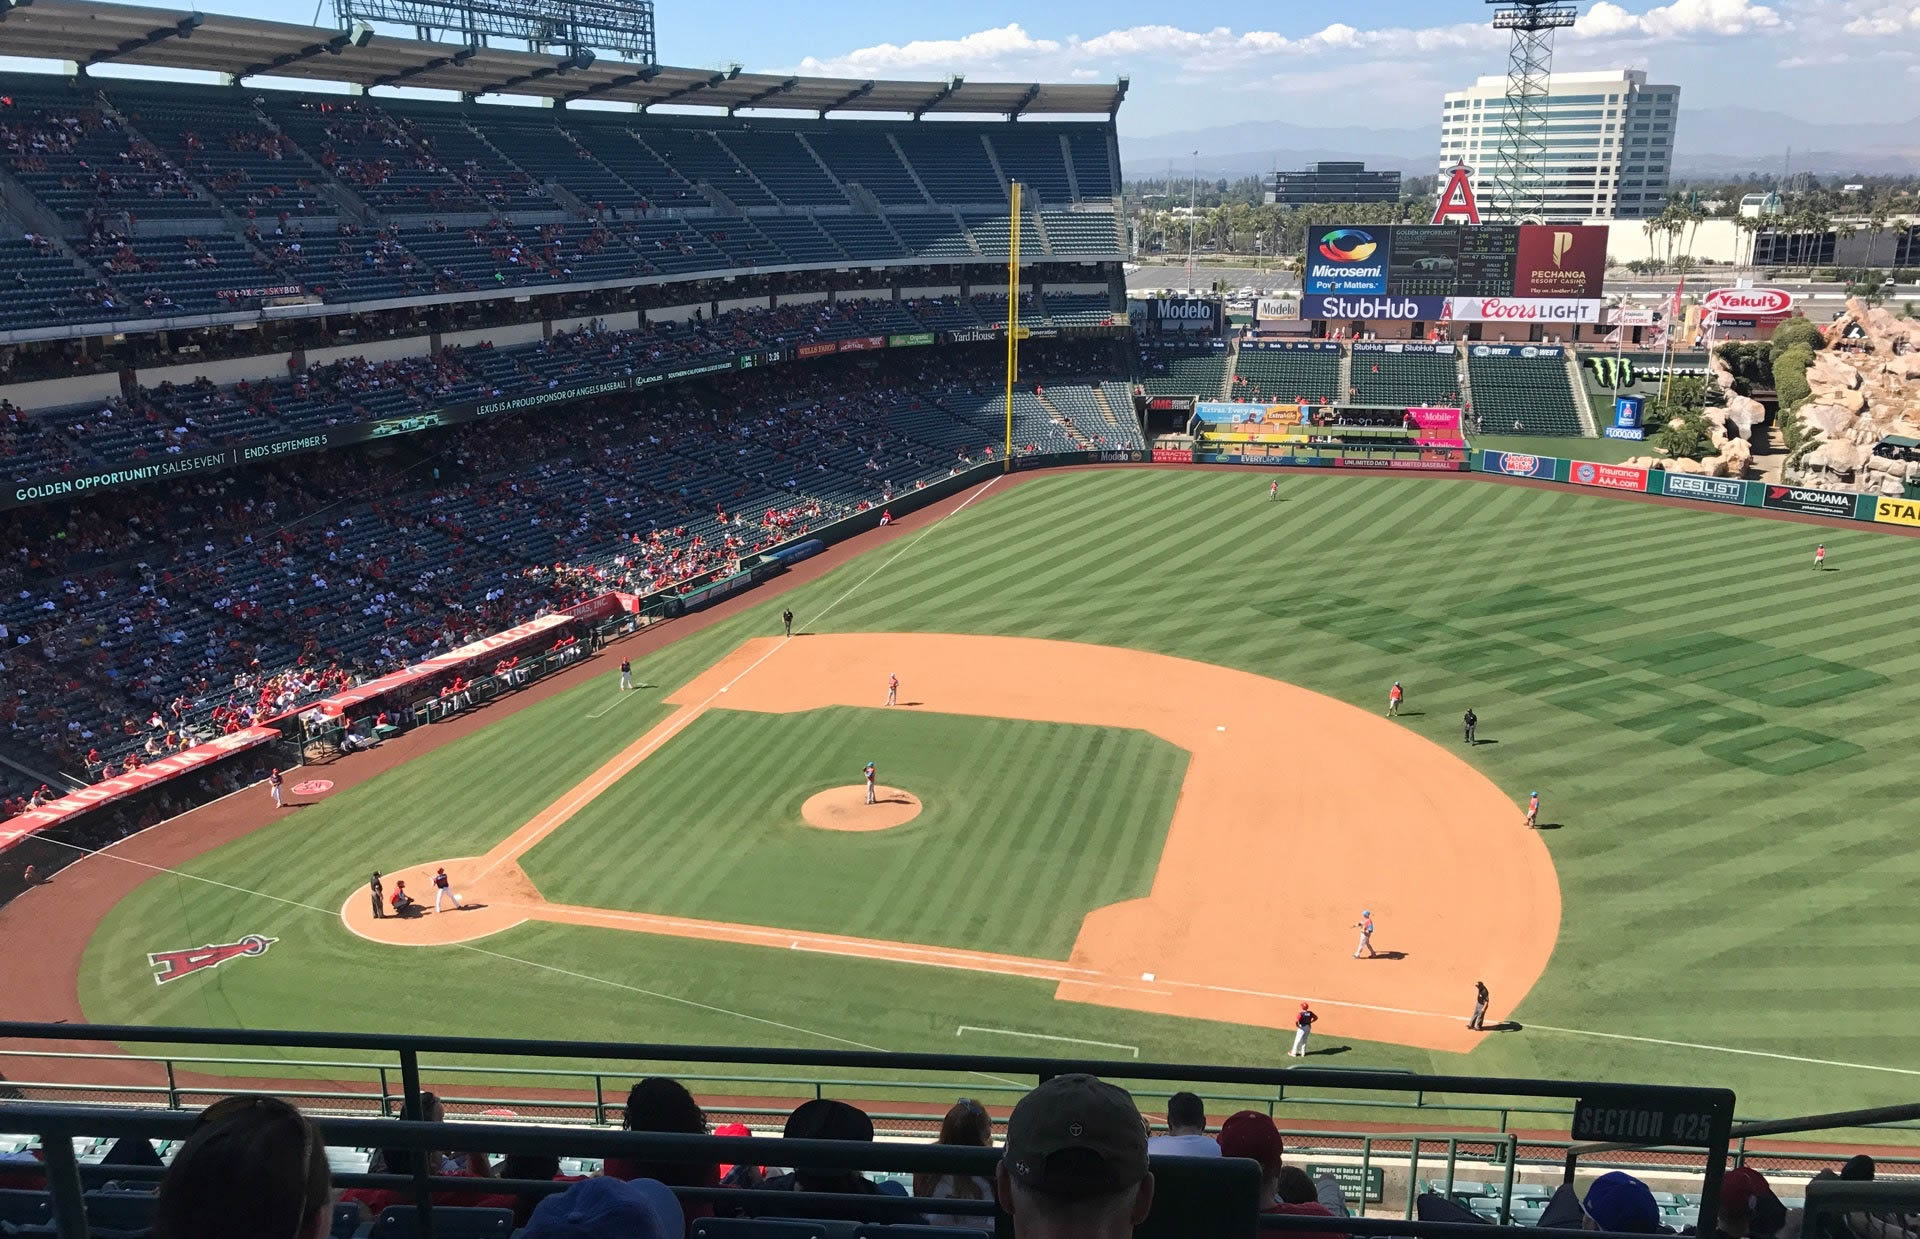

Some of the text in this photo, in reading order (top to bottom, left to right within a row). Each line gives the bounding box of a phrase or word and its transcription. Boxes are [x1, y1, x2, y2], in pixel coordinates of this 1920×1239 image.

[1531, 270, 1586, 279] PECHANGA
[268, 286, 300, 296] SKYBOX
[1322, 297, 1419, 319] StubHub
[1719, 295, 1778, 308] Yakult
[1157, 299, 1211, 319] Modelo
[1263, 302, 1295, 316] Modelo
[1481, 298, 1589, 319] Coors LIGHT
[952, 330, 996, 342] Yard House
[799, 343, 836, 356] WELLS FARGO
[1353, 343, 1384, 352] StubHub
[1404, 344, 1435, 352] StubHub
[642, 374, 664, 384] LEXUS
[476, 380, 627, 416] LEXUS IS A PROUD SPONSOR OF ANGELS BASEBALL
[1425, 412, 1449, 421] Mobile
[1100, 450, 1129, 462] Modelo
[1505, 453, 1534, 464] Jersey
[16, 434, 328, 501] GOLDEN OPPORTUNITY SALES EVENT ENDS SEPTEMBER 5
[1344, 459, 1375, 467] UNLIMITED
[1421, 461, 1450, 469] BASEBALL
[1598, 477, 1639, 489] AAA.com
[1789, 489, 1850, 506] YOKOHAMA
[1879, 502, 1920, 521] STA
[22, 752, 216, 822] WELCOME
[1579, 1107, 1713, 1142] SECTION 425
